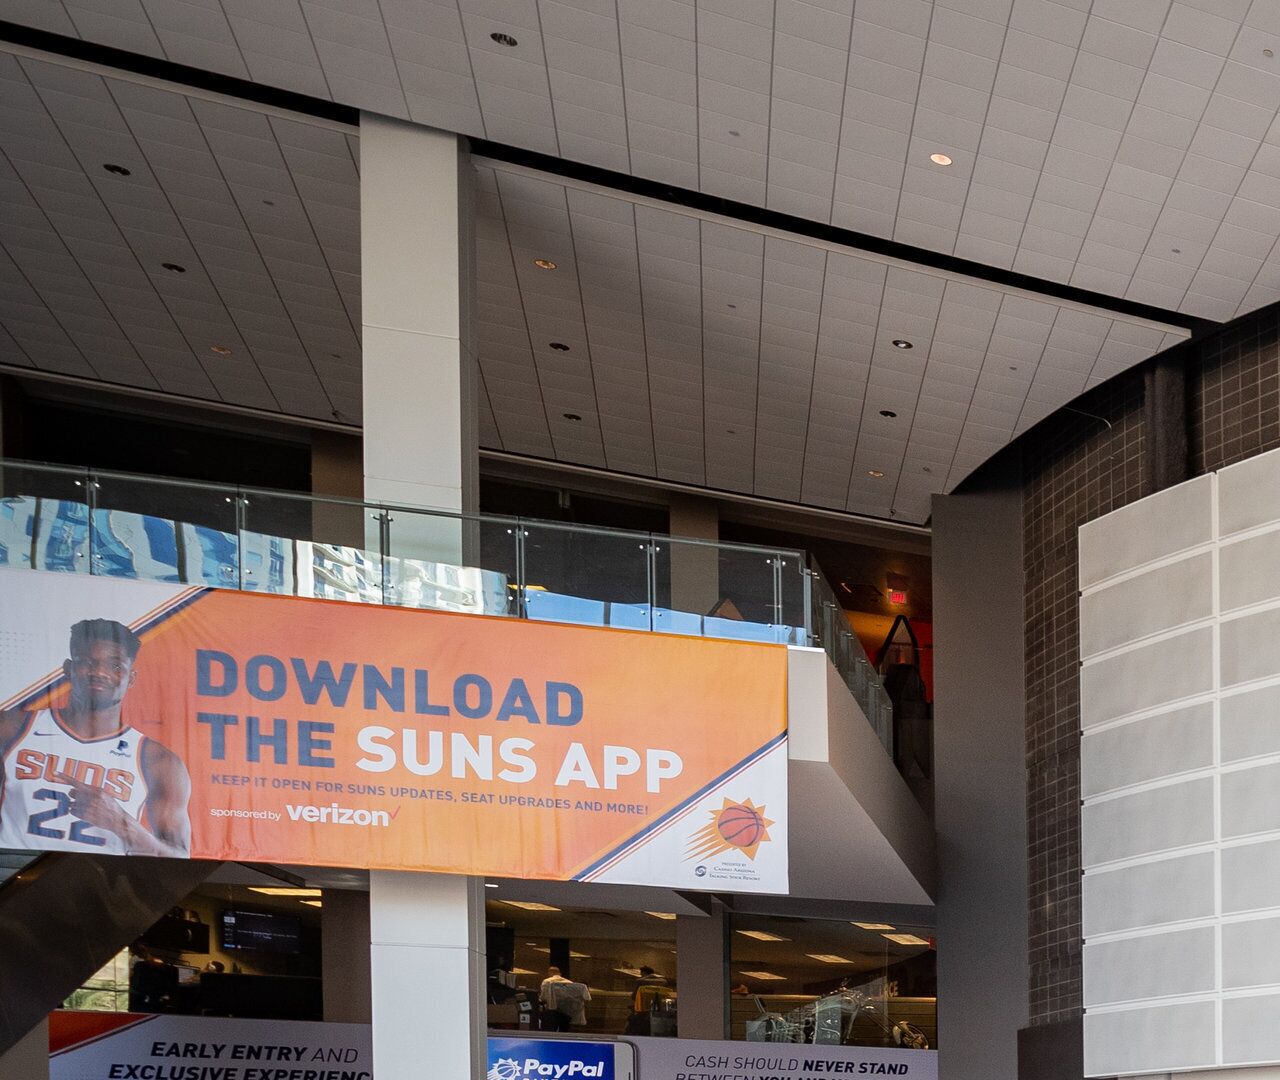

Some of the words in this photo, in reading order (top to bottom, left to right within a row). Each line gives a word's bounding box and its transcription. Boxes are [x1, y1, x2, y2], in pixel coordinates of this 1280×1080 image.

[195, 648, 584, 727] DOWNLOAD
[196, 711, 336, 769] THE
[355, 725, 538, 783] SUNS
[554, 741, 684, 794] APP
[211, 774, 250, 786] KEEP
[254, 775, 269, 788] IT
[272, 778, 311, 791] OPEN
[316, 780, 344, 794] FOR
[347, 783, 386, 797] SUNS
[390, 786, 456, 803] UPDATES,
[461, 792, 495, 804] SEAT
[499, 794, 571, 810] UPGRADES
[574, 800, 603, 812] AND
[606, 803, 649, 815] MORE!
[210, 806, 267, 820] sponsored
[268, 809, 281, 822] by
[286, 803, 389, 827] verizon
[150, 1041, 226, 1059] EARLY
[231, 1044, 309, 1062] ENTRY
[311, 1047, 359, 1064] AND
[523, 1058, 605, 1079] PayPal
[685, 1055, 729, 1069] CASH
[732, 1056, 799, 1071] SHOULD
[802, 1059, 855, 1074] NEVER
[858, 1062, 909, 1076] STAND
